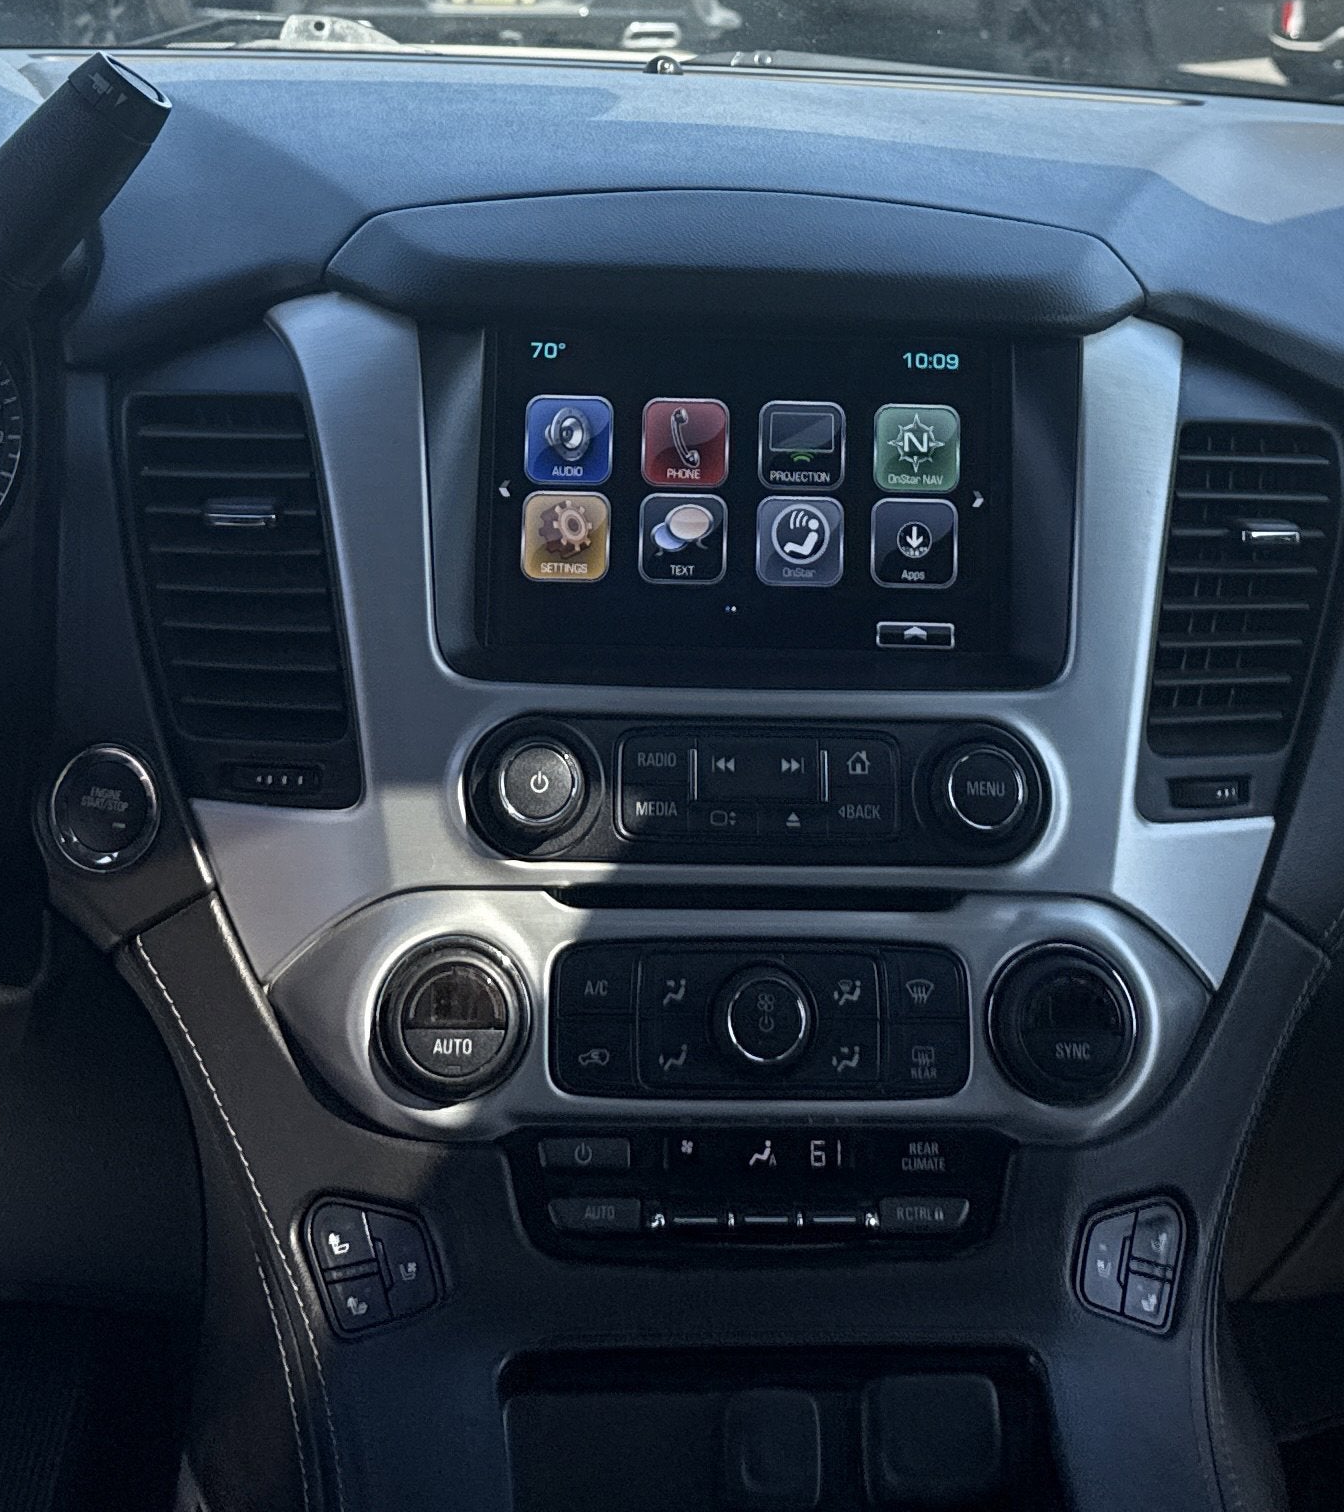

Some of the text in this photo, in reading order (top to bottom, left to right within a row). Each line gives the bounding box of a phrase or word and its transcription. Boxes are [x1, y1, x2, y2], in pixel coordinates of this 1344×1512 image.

[902, 352, 959, 370] 10:09
[552, 466, 583, 477] AUDIO
[666, 468, 701, 480] PHONE
[769, 470, 831, 484] PROJECTION
[887, 474, 943, 485] OnStar NAV
[540, 562, 588, 575] SETTINGS
[670, 564, 695, 576] TEXT
[782, 566, 816, 579] OnStar
[901, 569, 926, 582] Apps
[637, 752, 677, 769] RADIO
[966, 781, 1006, 798] MENU
[635, 801, 677, 817] MEDIA
[846, 803, 880, 821] BACK
[585, 979, 608, 996] A/C
[433, 1038, 472, 1055] AUTO
[1056, 1041, 1090, 1060] SYNC
[810, 1139, 842, 1167] 61
[909, 1141, 939, 1156] REAR
[901, 1157, 946, 1171] CLIMATE
[584, 1205, 616, 1220] AUTO
